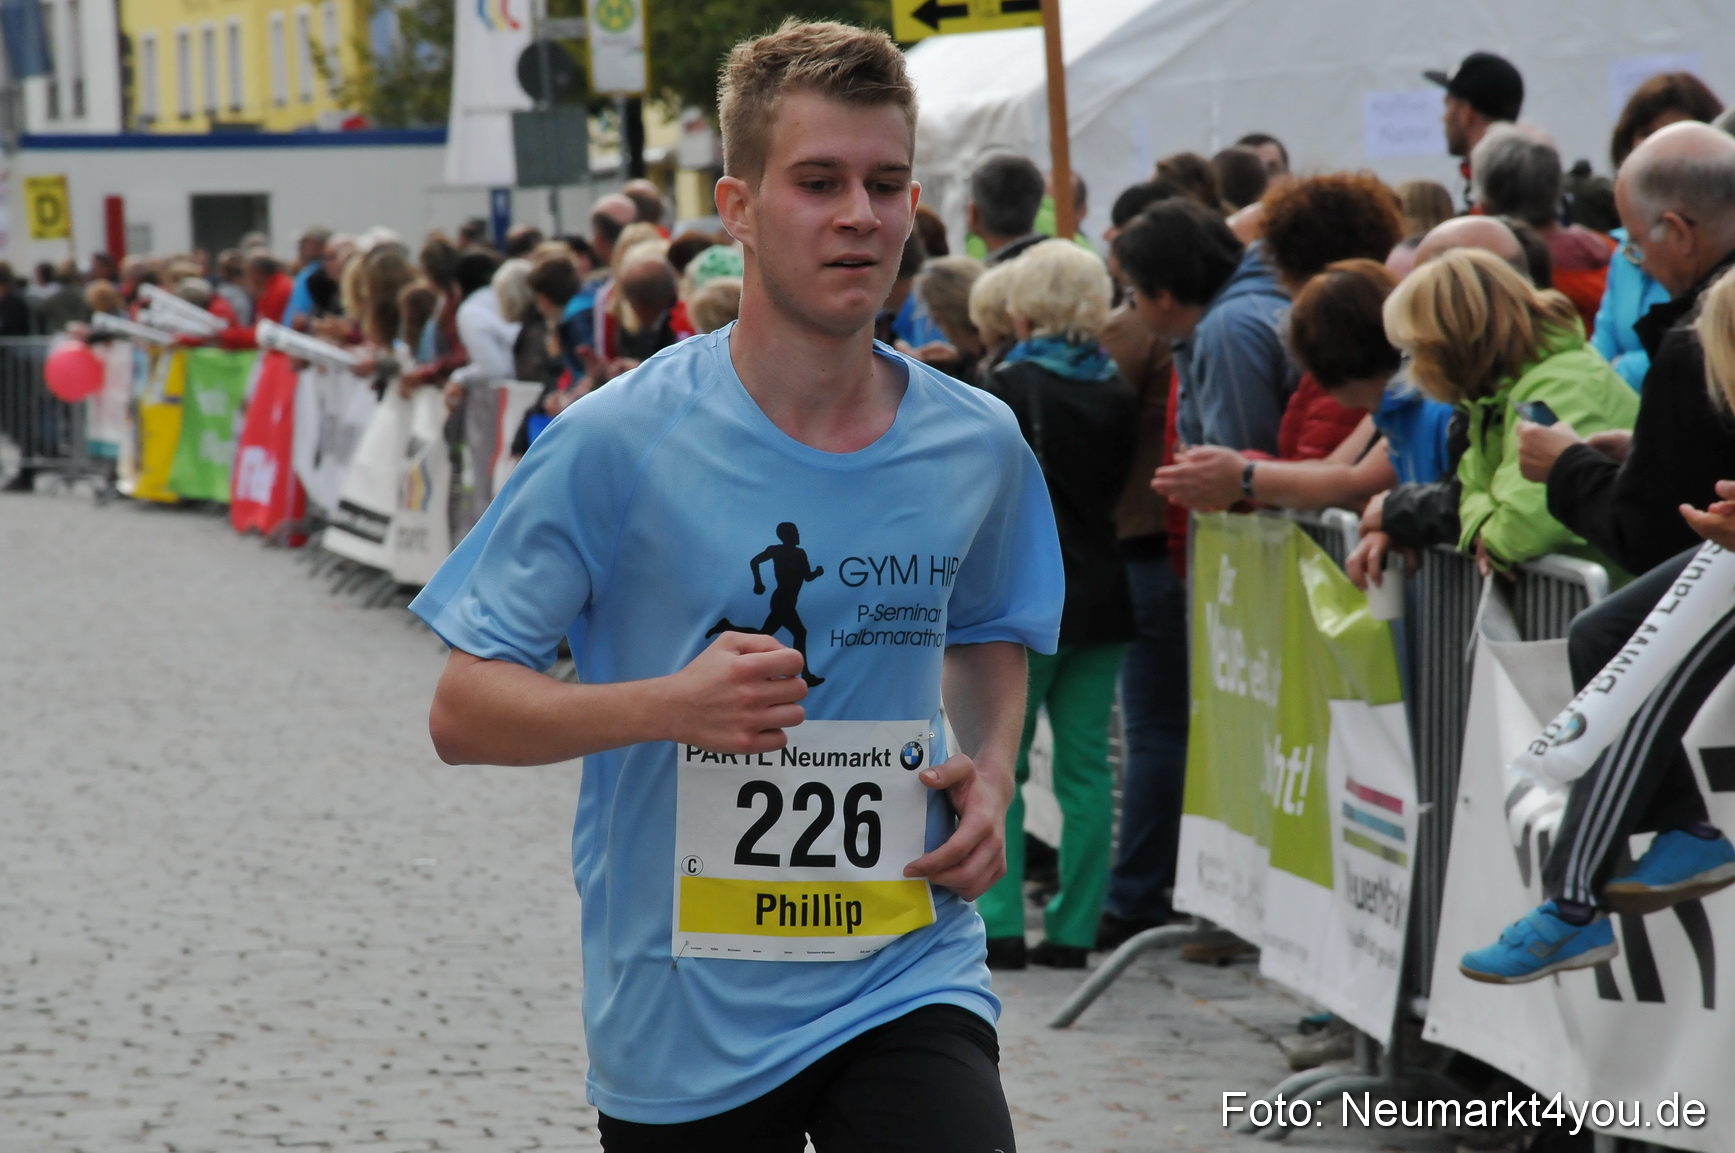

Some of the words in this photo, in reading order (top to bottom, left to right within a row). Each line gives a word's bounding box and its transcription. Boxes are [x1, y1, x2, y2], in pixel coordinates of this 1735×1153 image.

[35, 194, 62, 227] D
[838, 554, 918, 588] GYM
[857, 603, 942, 623] P-Seminar
[830, 629, 945, 647] Halbmaratho
[780, 746, 891, 767] Neumarkt
[734, 780, 883, 869] 226
[687, 858, 698, 874] C
[756, 893, 863, 934] Phillip
